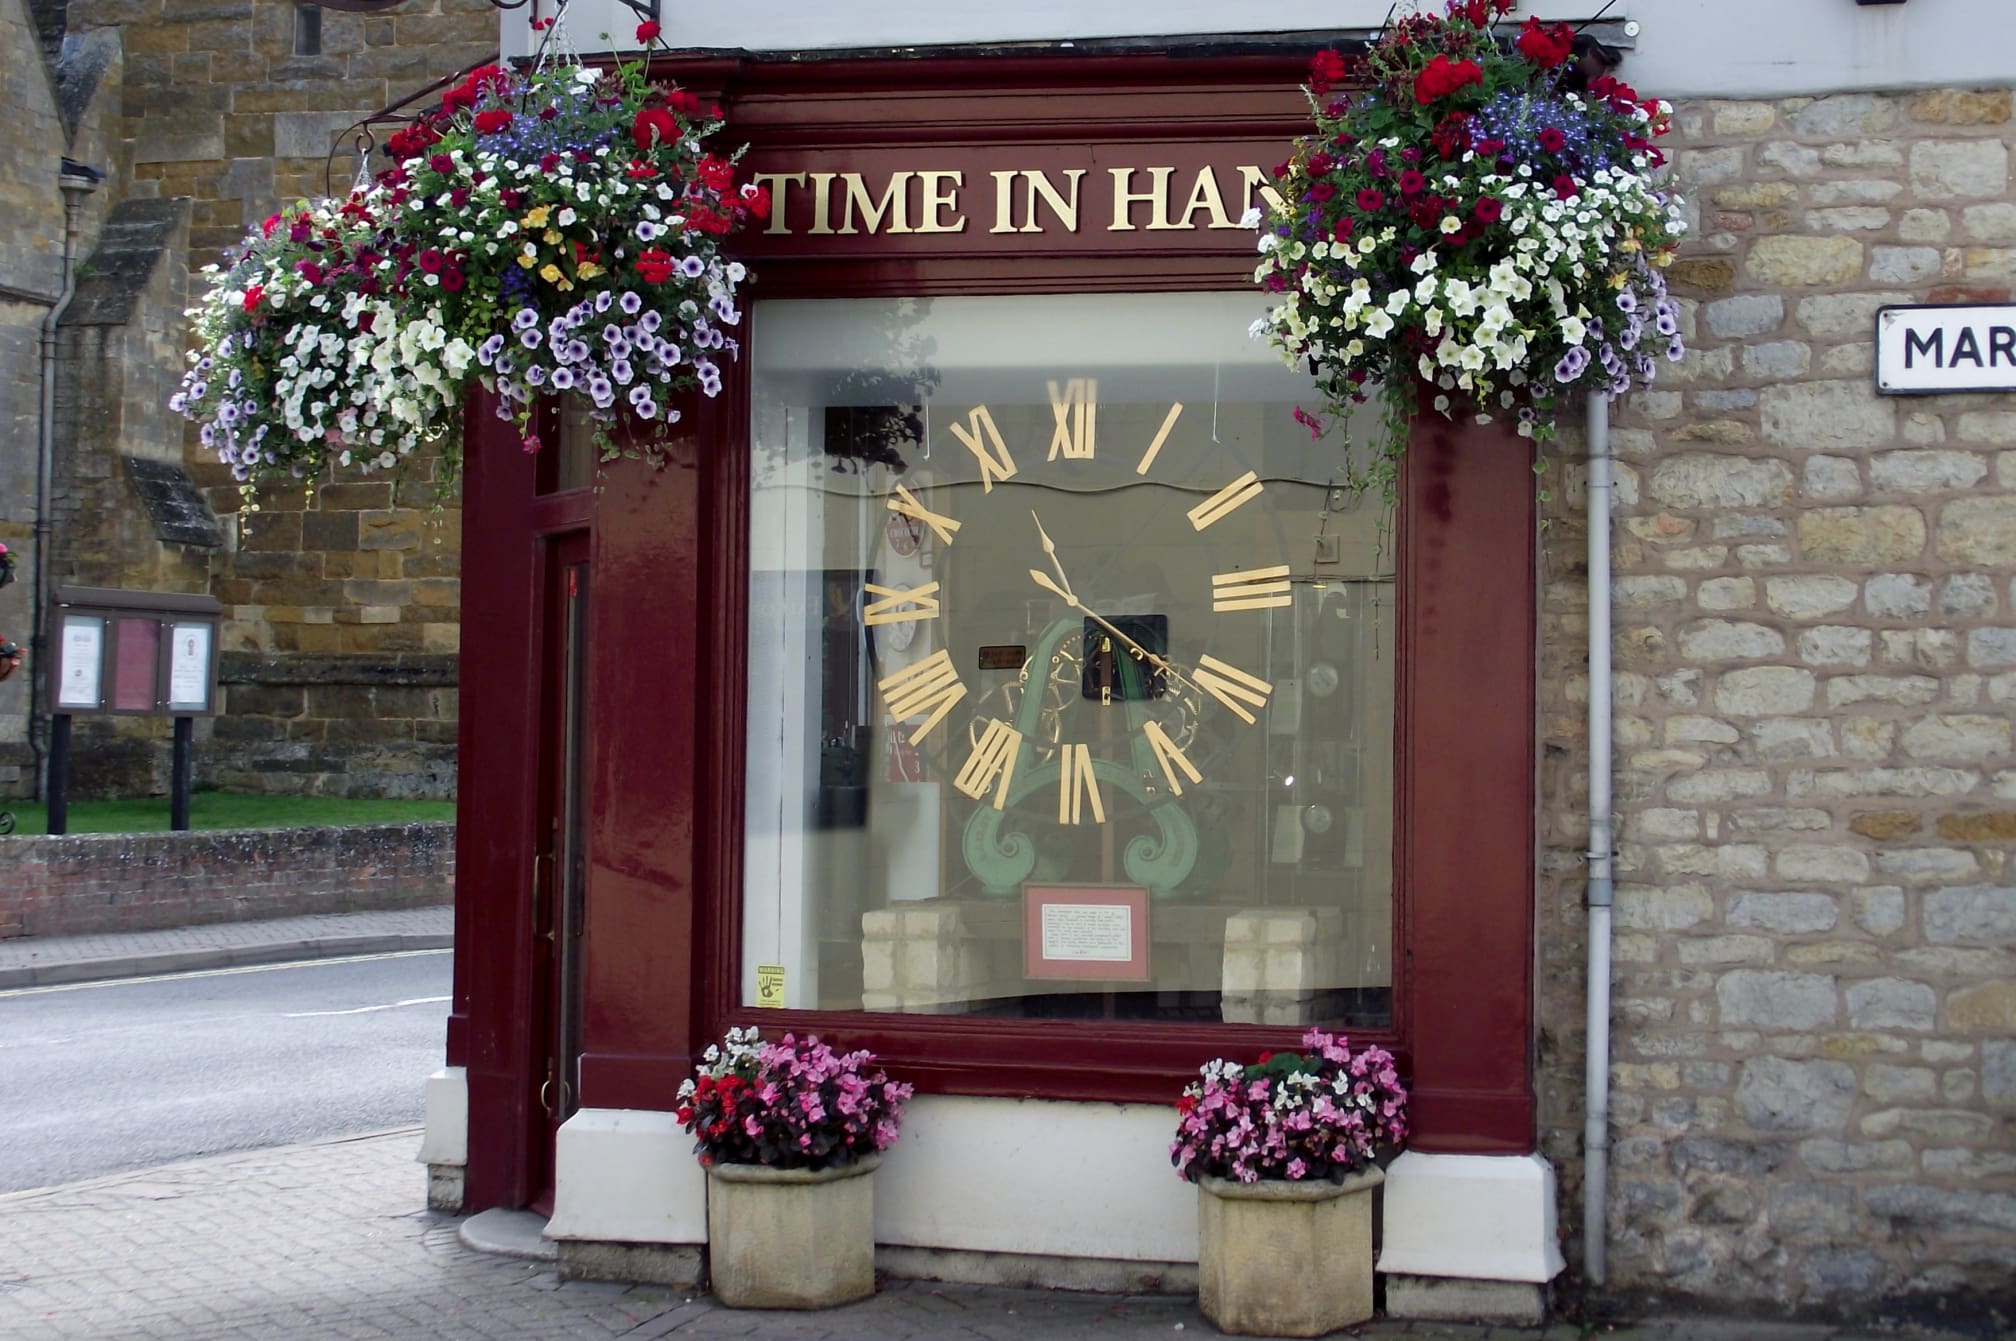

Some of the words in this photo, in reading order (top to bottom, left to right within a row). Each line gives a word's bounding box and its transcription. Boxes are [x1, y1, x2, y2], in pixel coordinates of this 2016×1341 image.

[753, 171, 966, 235] TIME
[989, 169, 1087, 233] IN
[1904, 326, 2016, 369] MAR
